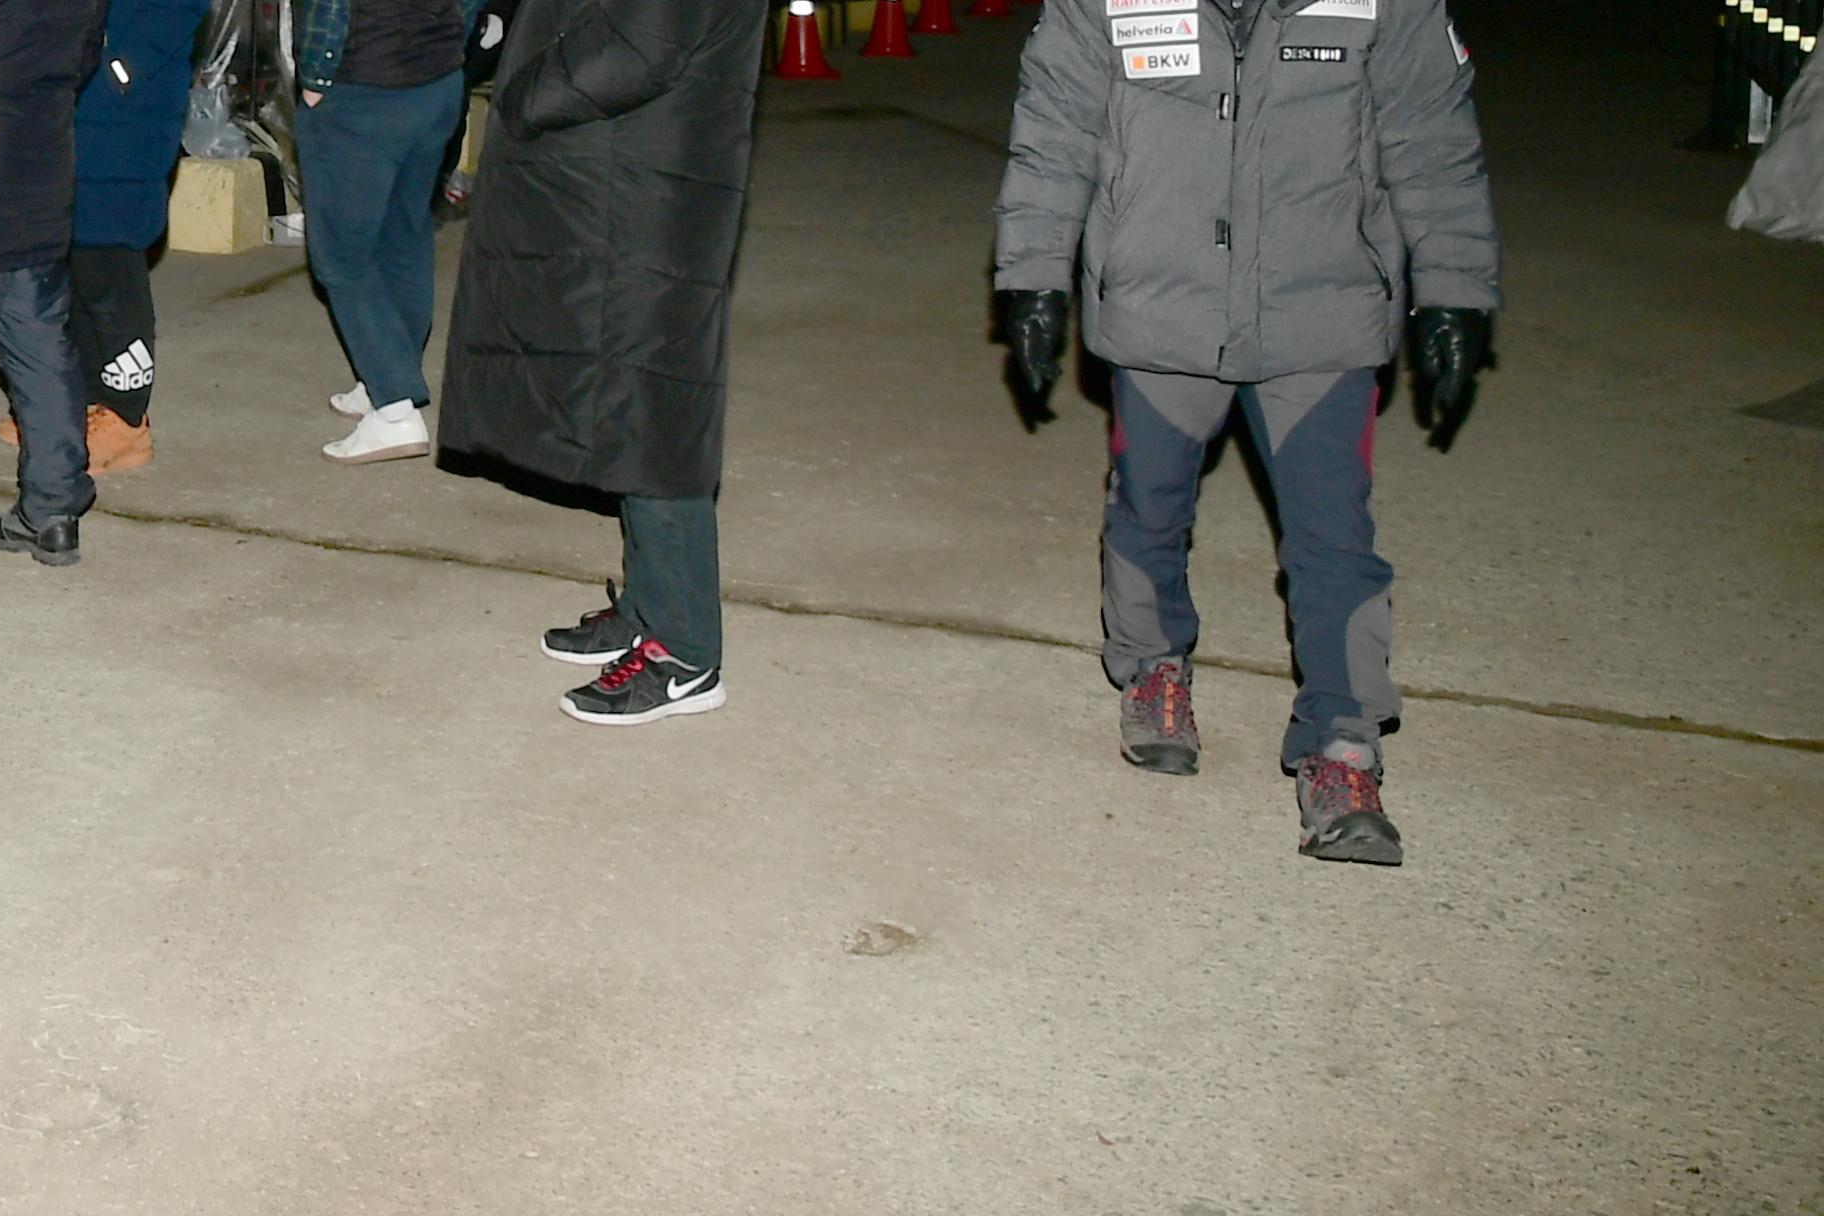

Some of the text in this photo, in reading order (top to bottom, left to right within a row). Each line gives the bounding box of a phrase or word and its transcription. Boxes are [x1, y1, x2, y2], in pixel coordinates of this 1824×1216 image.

[1117, 24, 1173, 38] helvetia
[1147, 53, 1190, 69] BKW
[100, 369, 154, 392] adida
